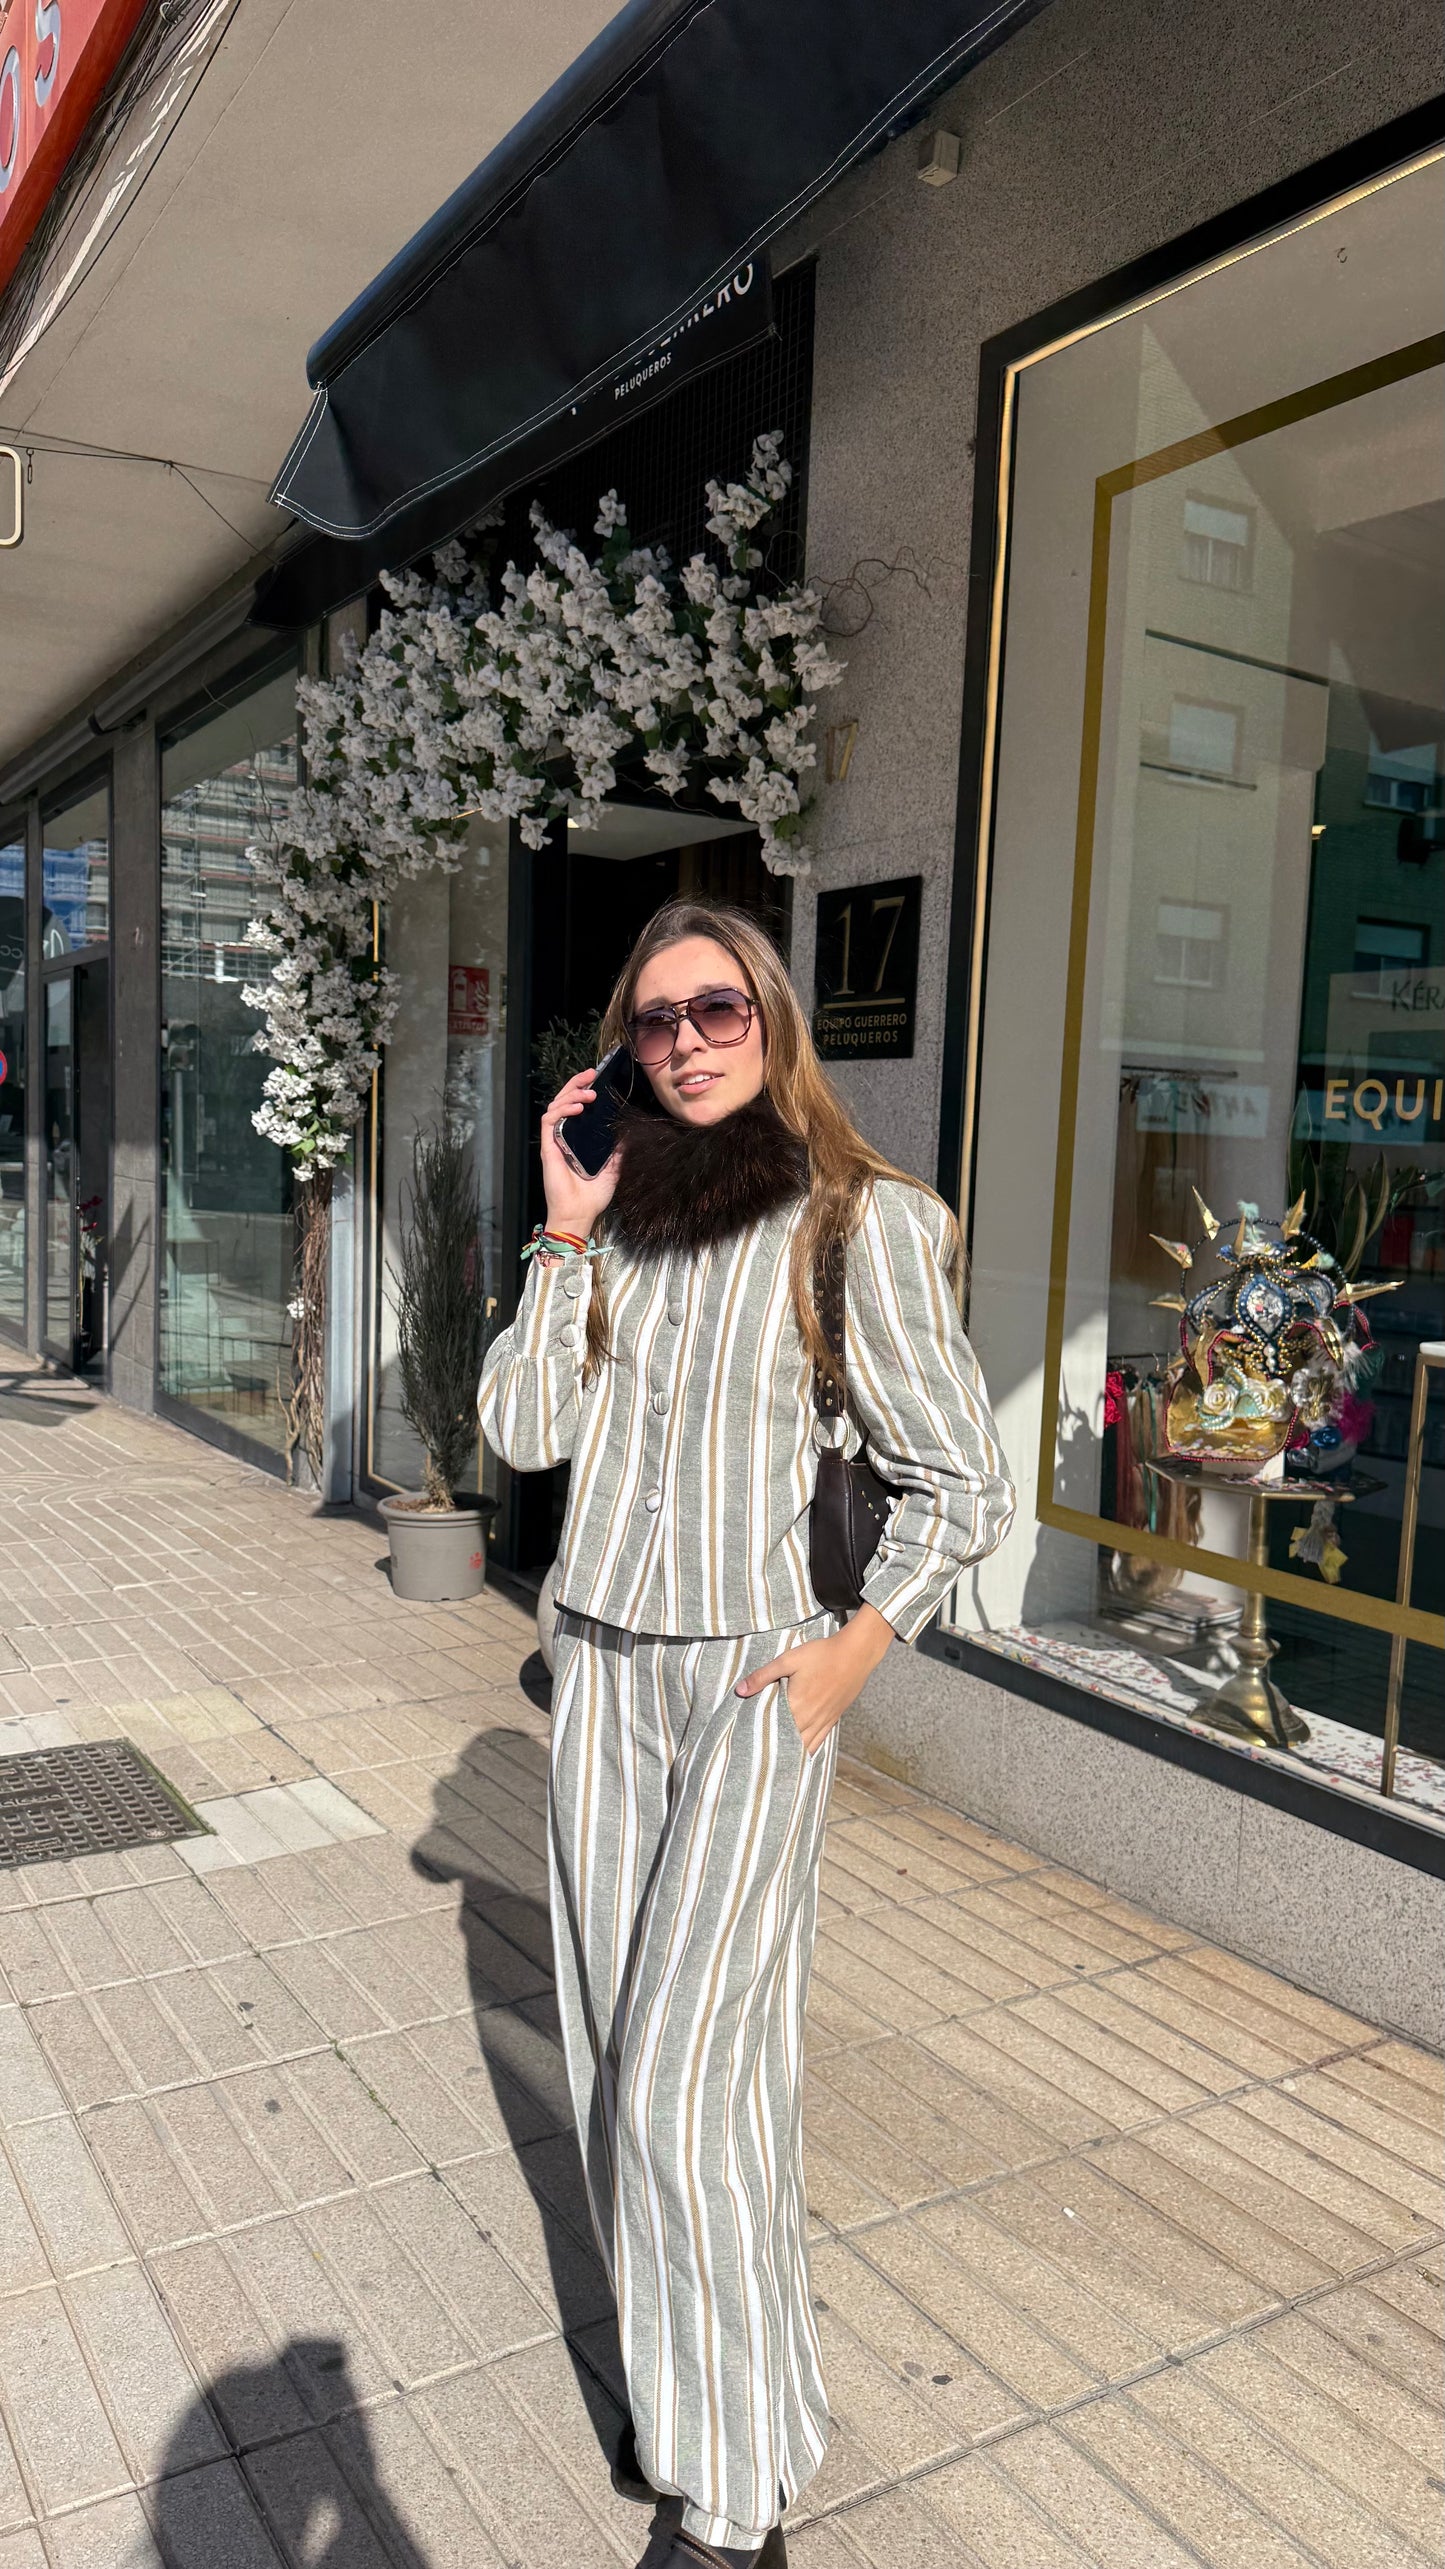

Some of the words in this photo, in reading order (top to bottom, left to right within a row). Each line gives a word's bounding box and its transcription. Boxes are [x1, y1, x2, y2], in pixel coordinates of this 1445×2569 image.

[614, 352, 672, 400] PELUQUEROS
[833, 895, 906, 995] 17
[1391, 980, 1445, 1011] KÉR
[854, 1013, 907, 1028] GUERRERO
[823, 1030, 899, 1047] PELUQUEROS
